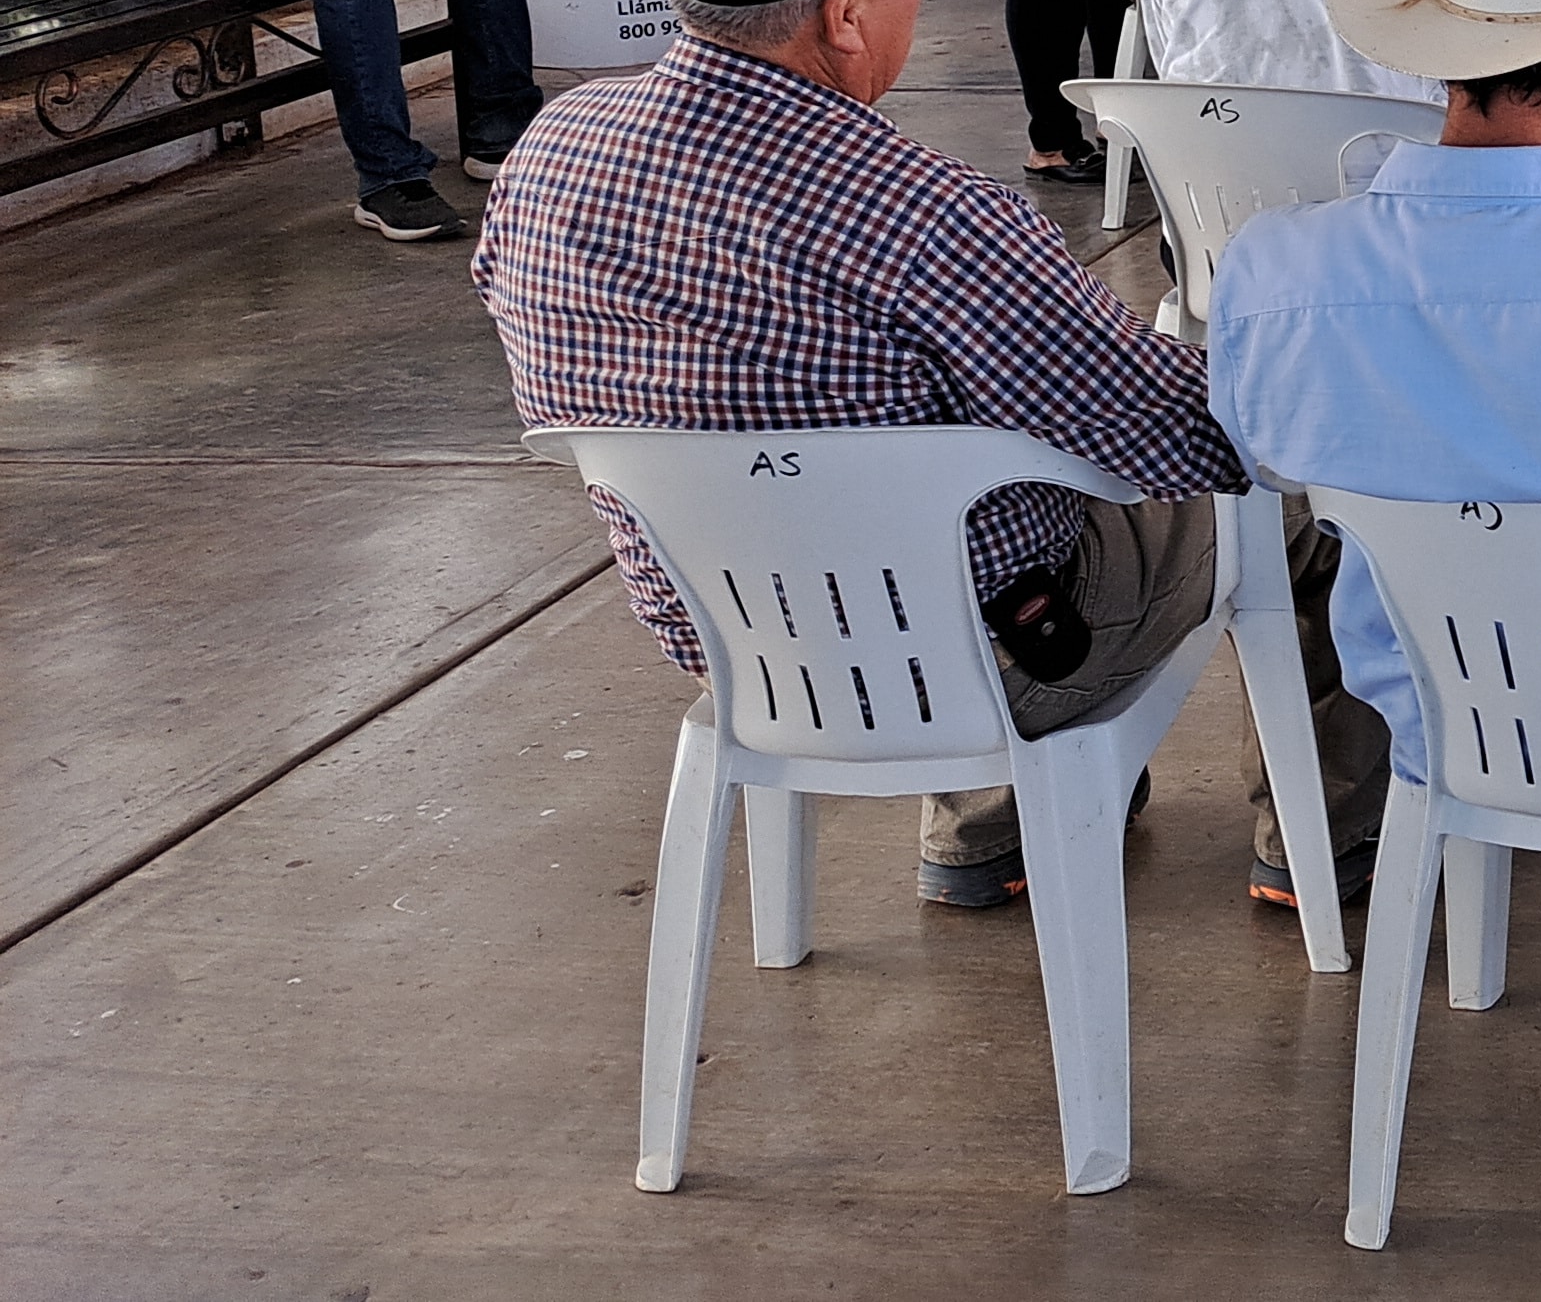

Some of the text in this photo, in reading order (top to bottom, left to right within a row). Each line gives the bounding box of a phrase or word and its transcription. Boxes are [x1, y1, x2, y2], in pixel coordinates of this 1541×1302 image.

[619, 24, 655, 40] 800
[1200, 97, 1240, 124] AS
[749, 451, 801, 477] AS
